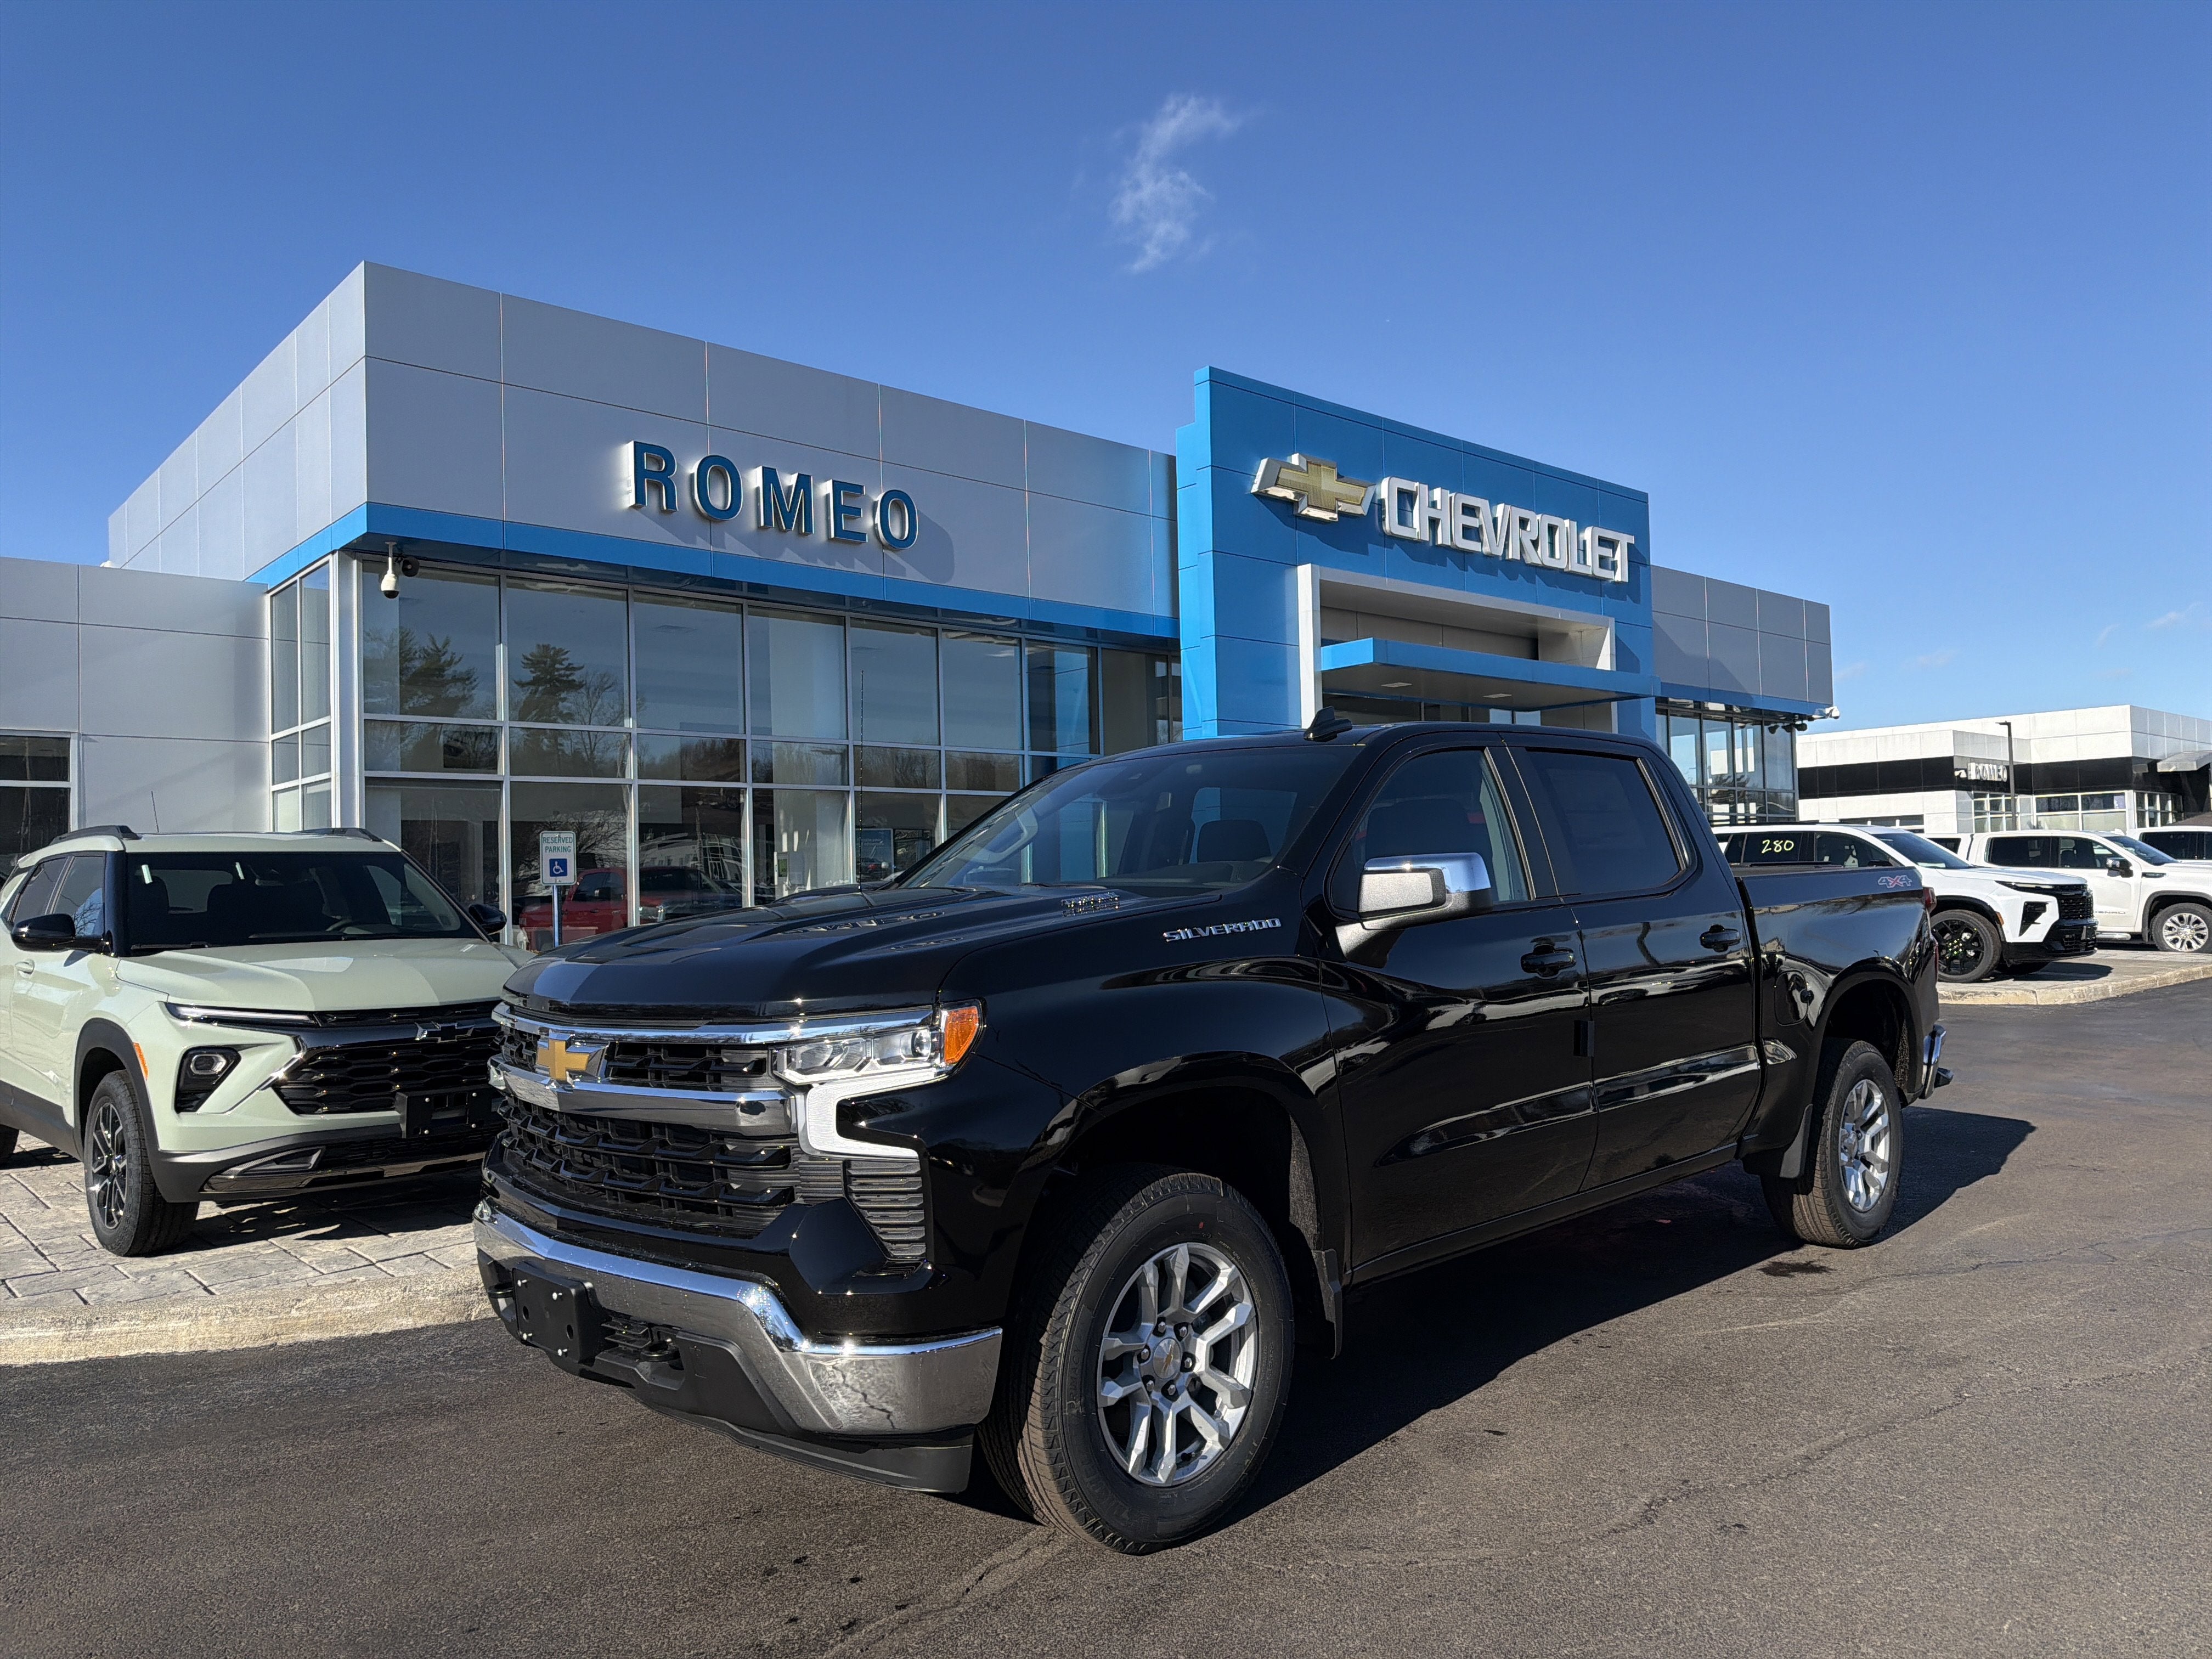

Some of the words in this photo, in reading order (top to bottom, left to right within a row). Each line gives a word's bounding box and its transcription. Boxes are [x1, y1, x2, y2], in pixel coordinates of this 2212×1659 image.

[629, 441, 918, 549] ROMEO
[1382, 477, 1634, 582] CHEVROLET
[1762, 839, 1795, 854] 280
[1163, 918, 1282, 942] SILVERADO
